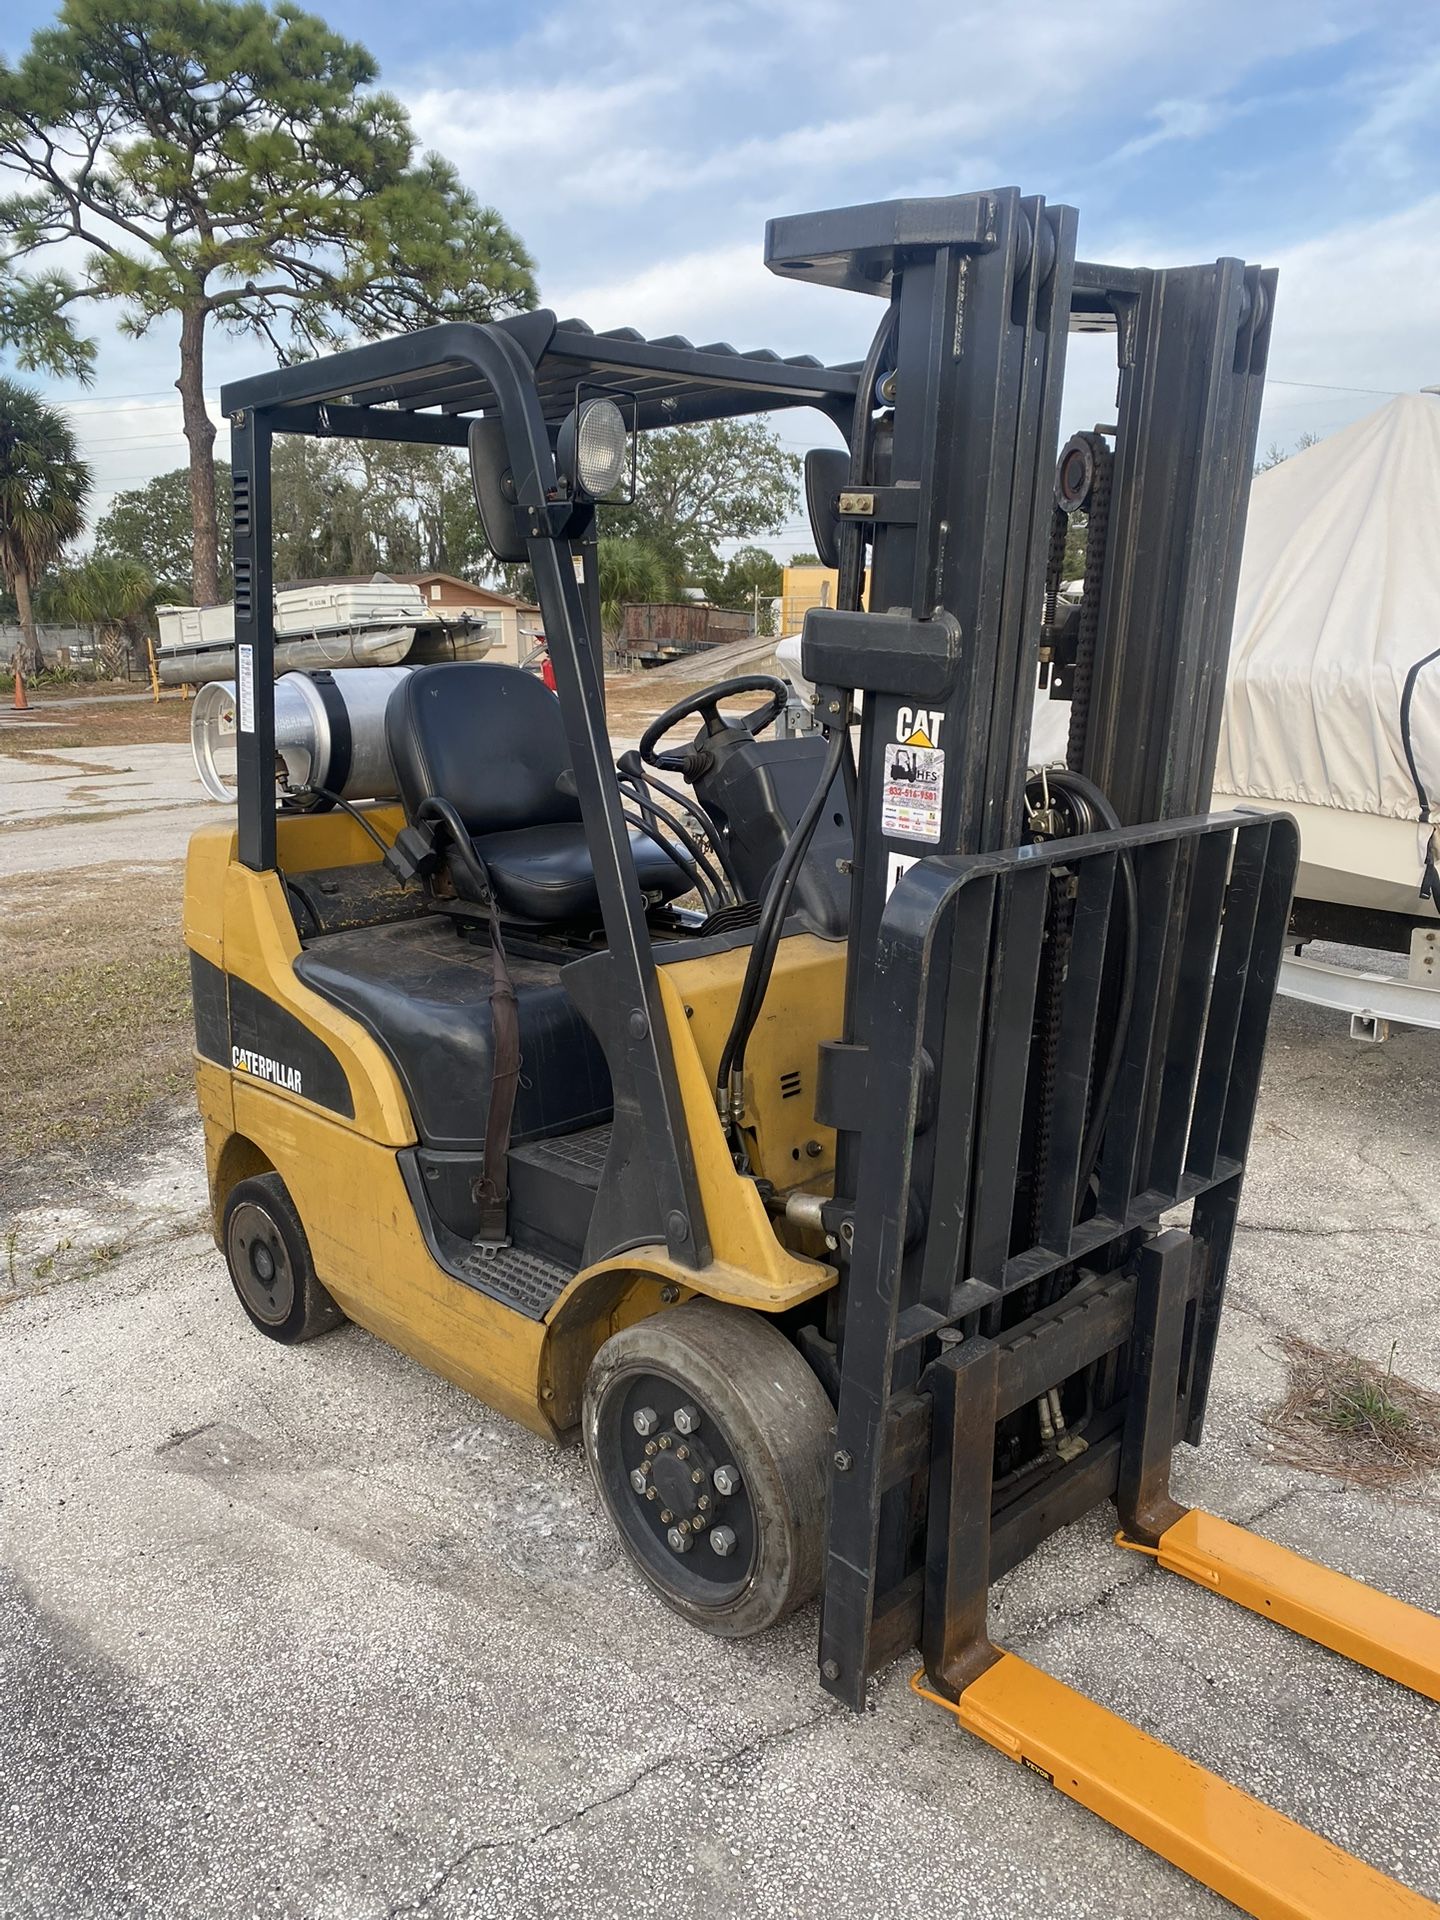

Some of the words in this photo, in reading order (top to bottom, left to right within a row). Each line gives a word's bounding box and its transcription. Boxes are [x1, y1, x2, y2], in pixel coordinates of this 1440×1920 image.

[896, 706, 945, 749] CAT
[917, 770, 938, 782] HFS
[888, 786, 937, 801] 832-516-9581
[232, 1045, 302, 1094] CATERPILLAR
